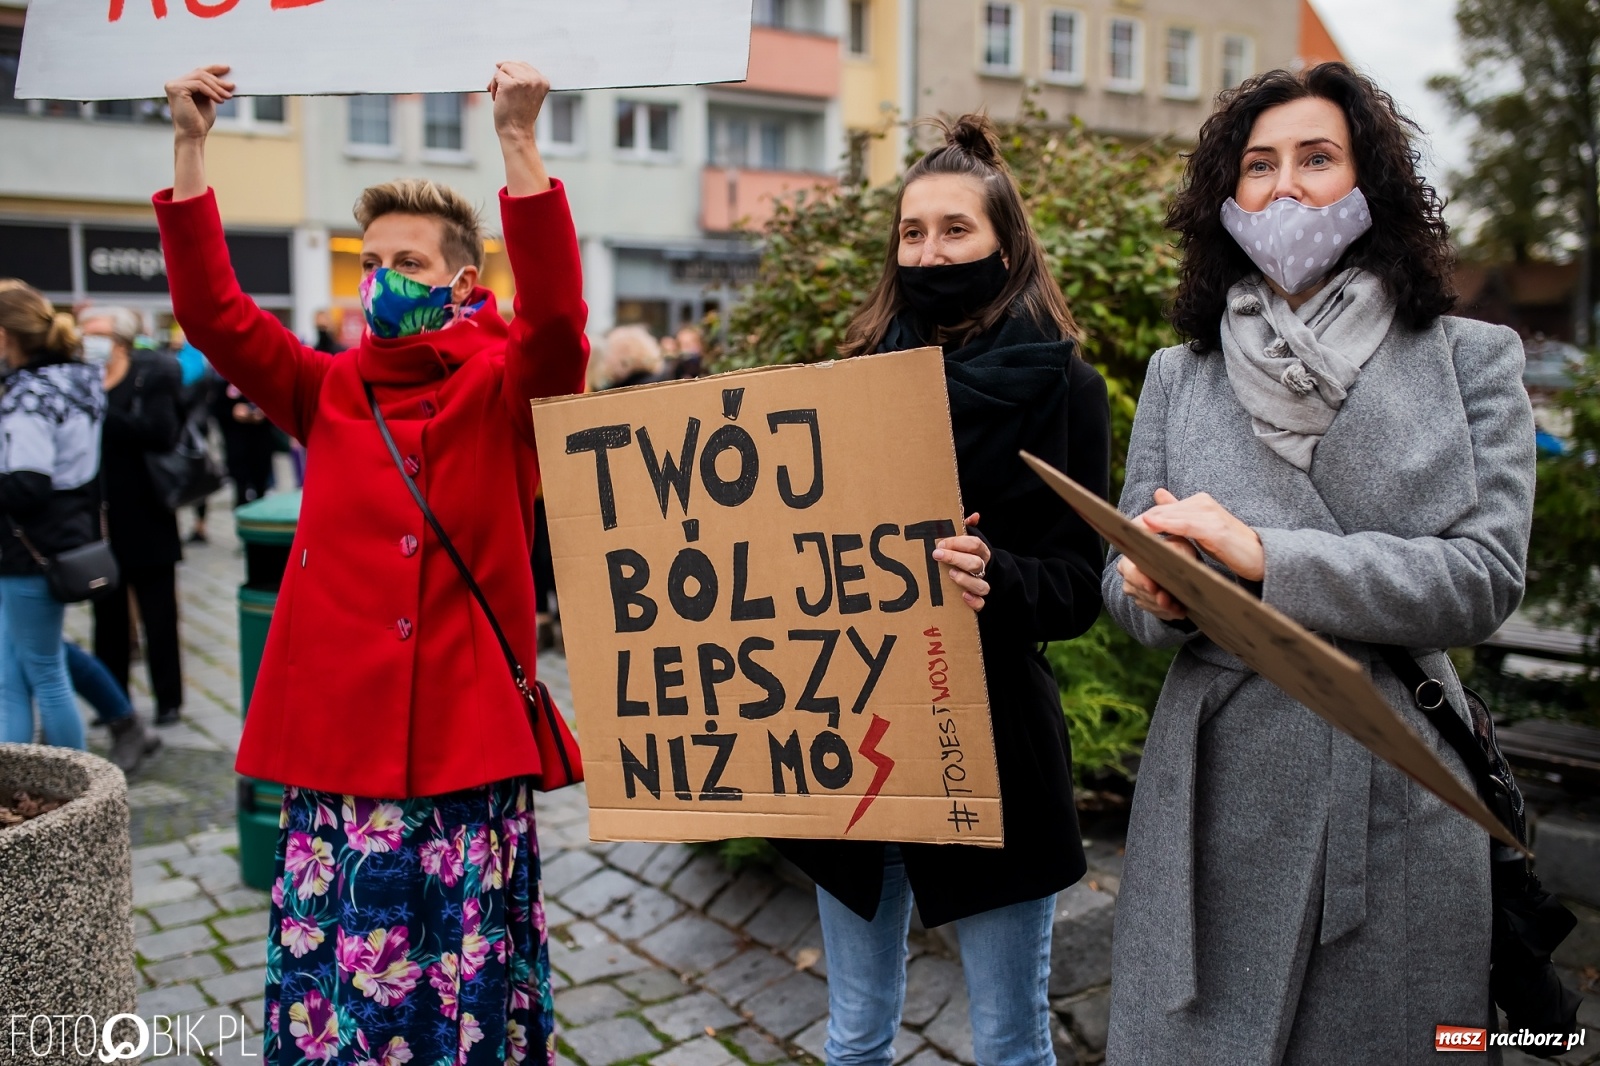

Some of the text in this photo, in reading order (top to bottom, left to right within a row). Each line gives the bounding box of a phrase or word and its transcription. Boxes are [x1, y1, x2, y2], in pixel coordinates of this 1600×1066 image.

[565, 387, 824, 531] TWÓJ
[605, 518, 957, 633] BÓL JEST
[616, 625, 898, 719] LEPSZY
[618, 719, 744, 802] NIŻ
